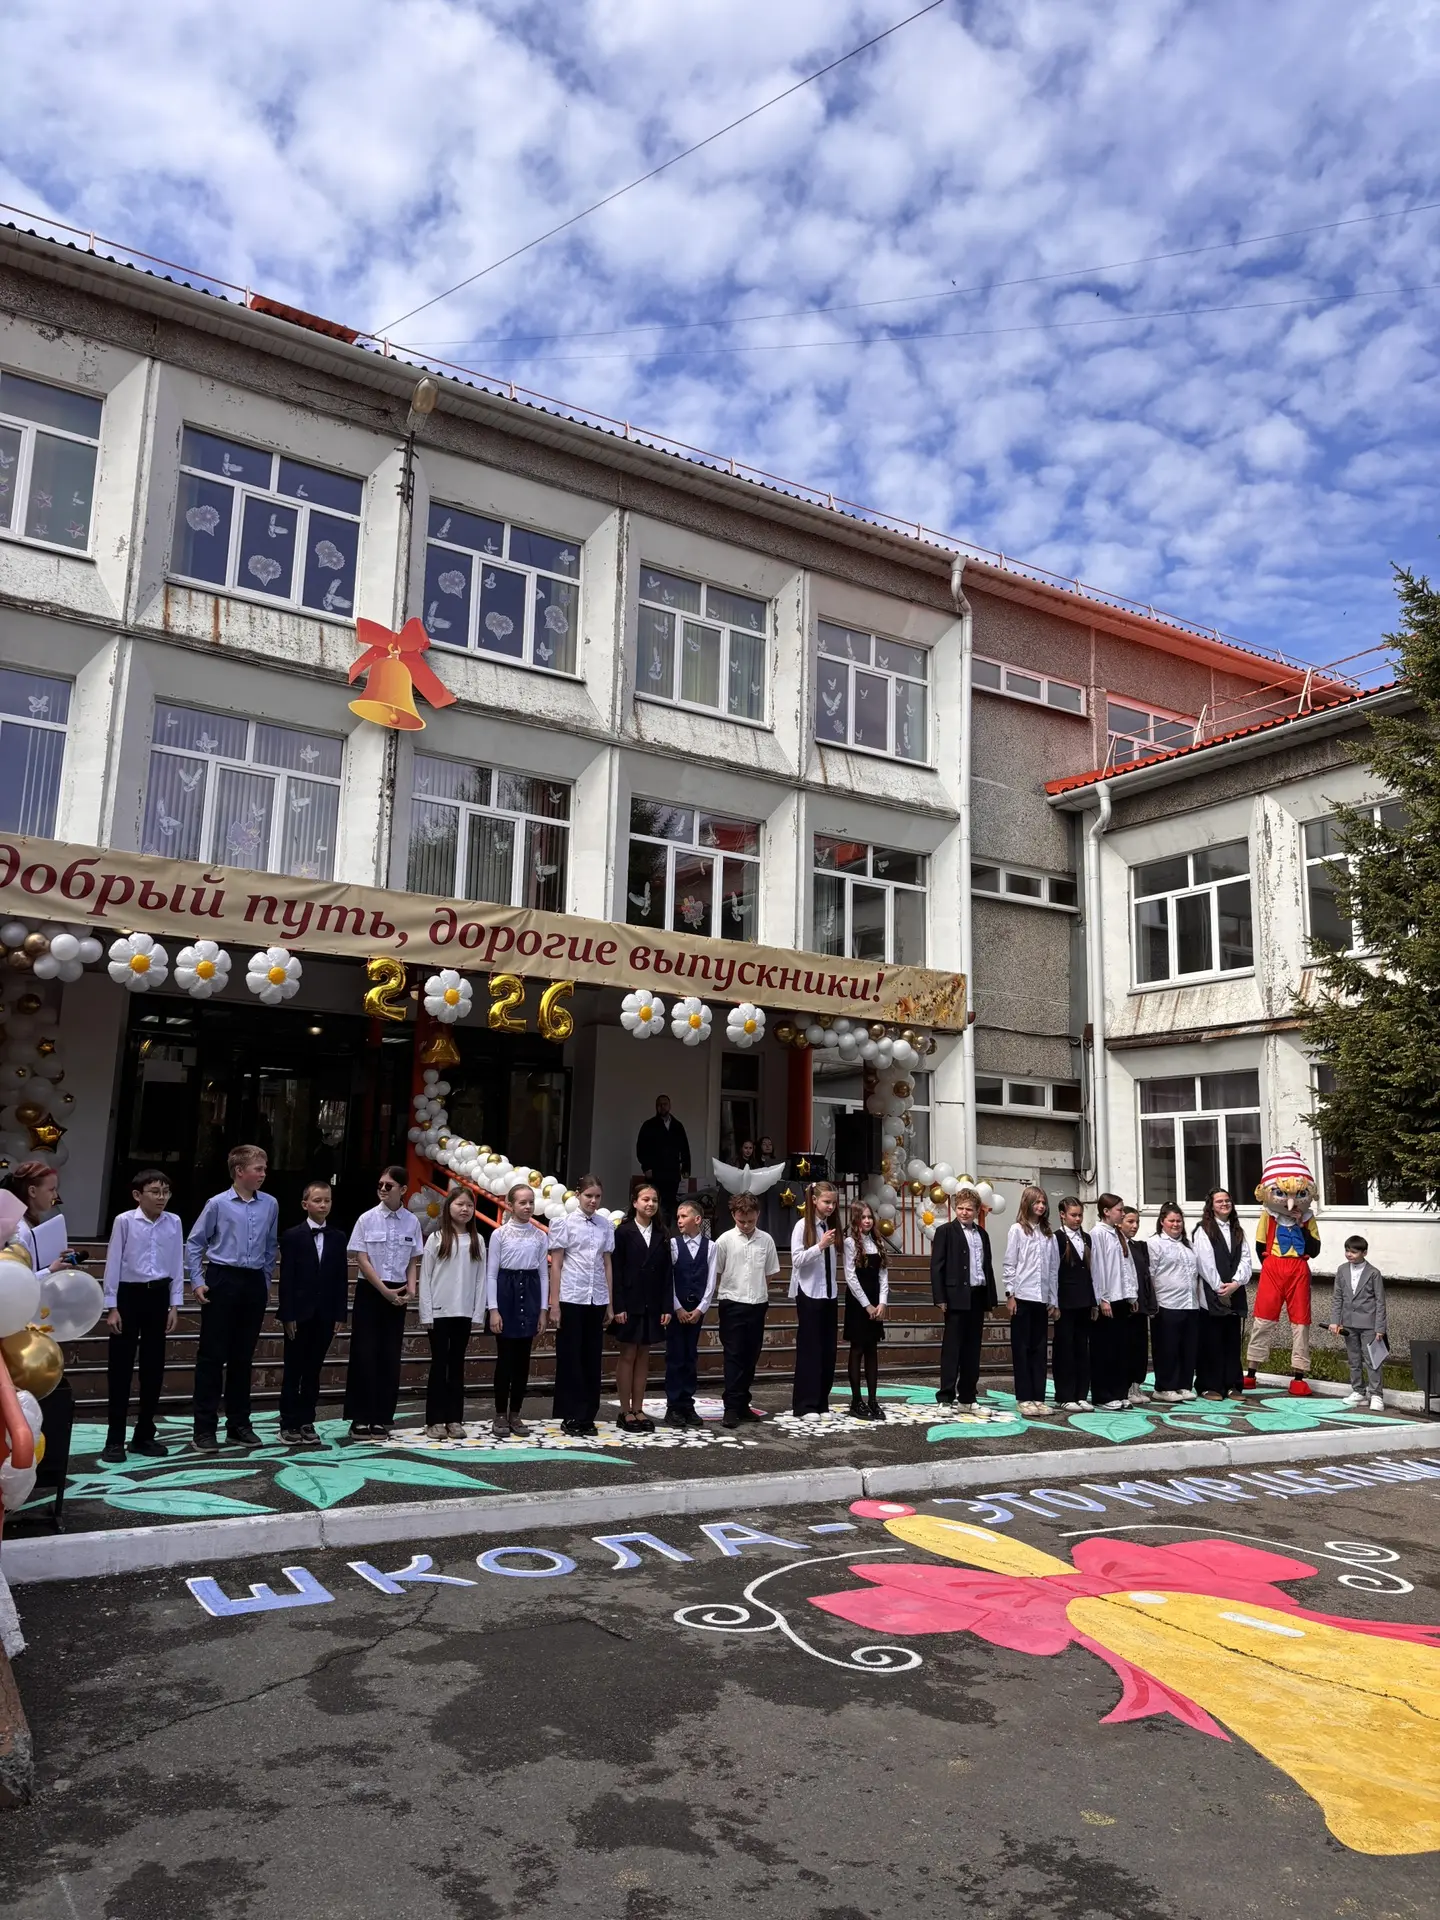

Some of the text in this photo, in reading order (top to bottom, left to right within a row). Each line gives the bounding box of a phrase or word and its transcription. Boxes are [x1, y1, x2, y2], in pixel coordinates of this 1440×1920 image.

[243, 893, 409, 948] путь,
[428, 905, 618, 966] дорогие
[629, 943, 886, 1002] выпускники!
[185, 1521, 810, 1617] ШКОЛА
[932, 1488, 1107, 1524] ЭТО
